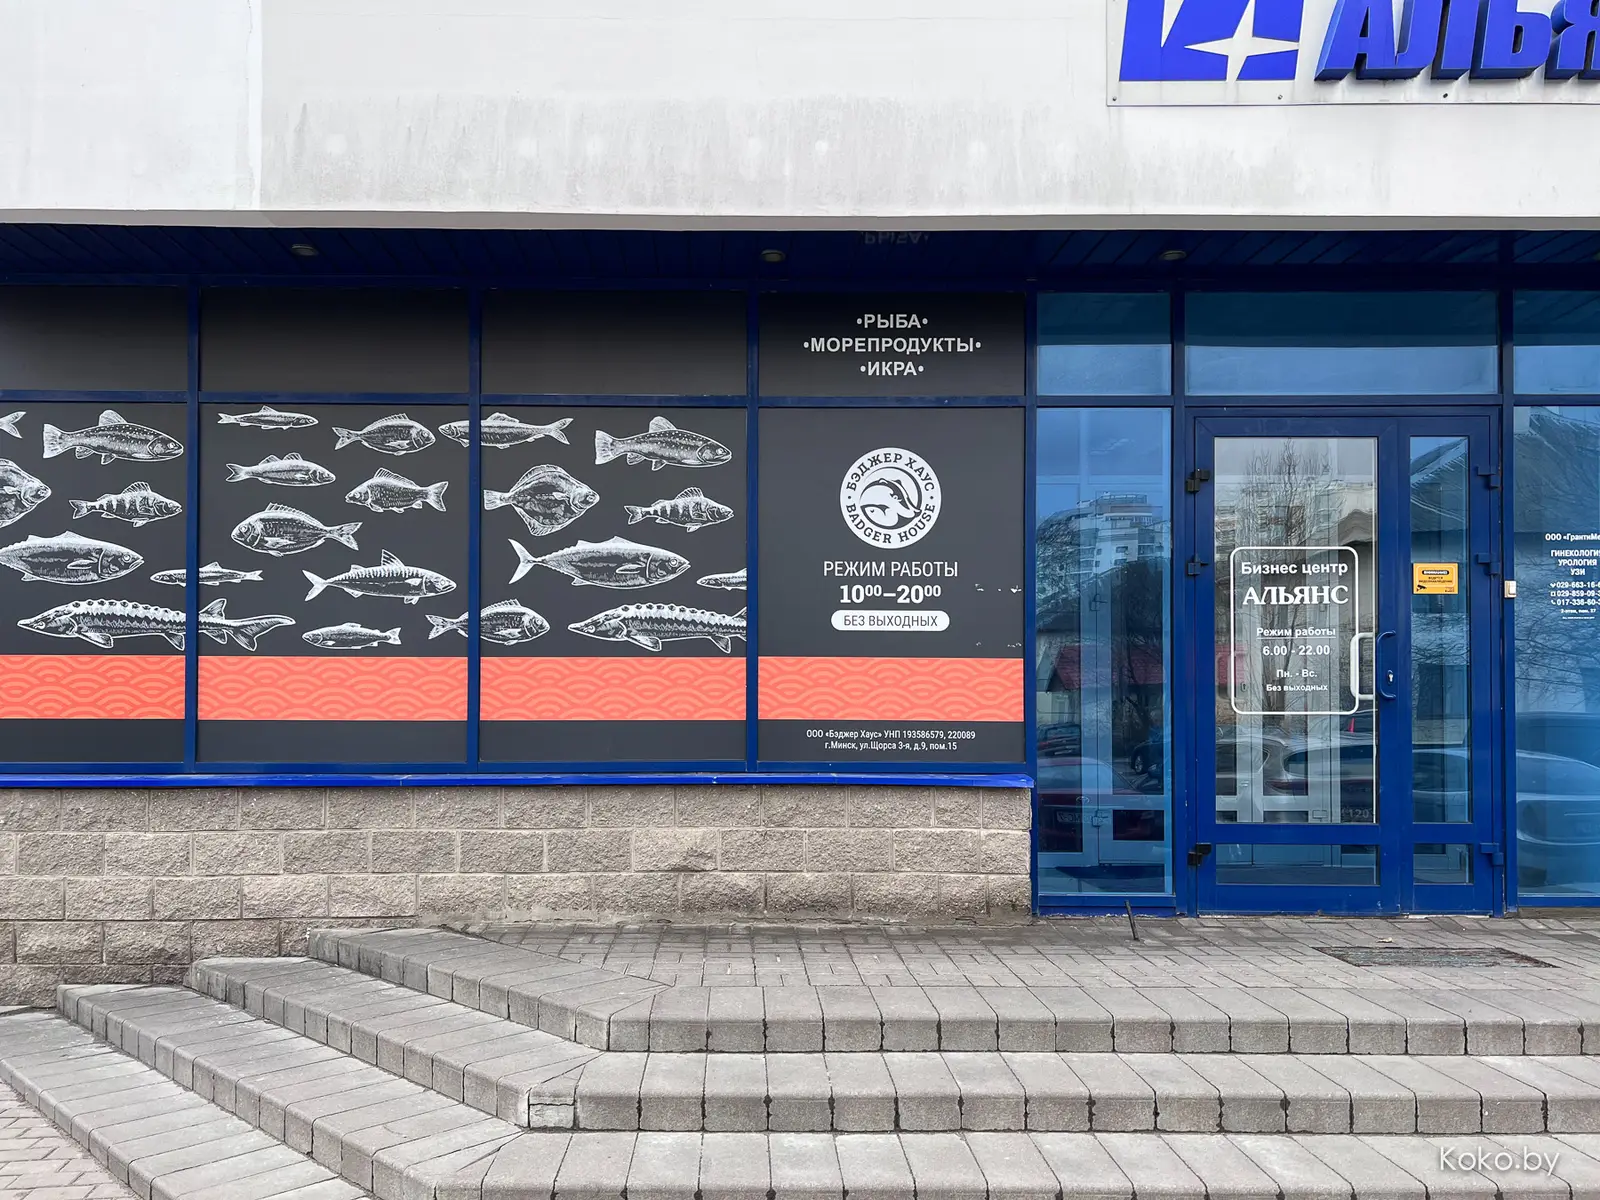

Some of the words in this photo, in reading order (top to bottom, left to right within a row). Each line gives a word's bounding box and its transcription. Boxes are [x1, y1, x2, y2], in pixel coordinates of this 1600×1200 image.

[846, 452, 902, 492] БЭДЖЕР
[905, 457, 935, 492] ХАУС
[846, 504, 892, 544] BADGER
[898, 503, 935, 542] HOUSE
[1545, 533, 1561, 541] ООО
[823, 561, 885, 577] РЕЖИМ
[891, 561, 958, 577] РАБОТЫ
[1241, 562, 1297, 574] Бизнес
[1302, 563, 1348, 576] центр
[1570, 568, 1585, 576] УЗИ
[1243, 585, 1349, 605] АЛЬЯНС
[844, 615, 865, 626] БЕЗ
[869, 615, 938, 628] ВЫХОДНЫХ
[1256, 628, 1292, 637] Режим
[1295, 627, 1336, 638] работы
[1262, 646, 1287, 656] 6.00
[1298, 645, 1330, 656] 22.00
[1276, 670, 1292, 678] Пн.
[1302, 669, 1317, 678] Вс.
[1266, 684, 1281, 692] Без
[1283, 684, 1328, 692] выходных
[806, 730, 823, 738] ООО
[825, 730, 858, 740] «Бэджер
[860, 730, 882, 740] Хаус»
[884, 730, 900, 739] УНП
[903, 731, 946, 740] 193586579,
[948, 731, 976, 739] 220089
[825, 742, 857, 750] г.Минск,
[860, 742, 897, 751] ул.Щорса
[898, 742, 912, 750] 3-я,
[914, 742, 928, 751] д.9,
[929, 742, 957, 750] пом.15
